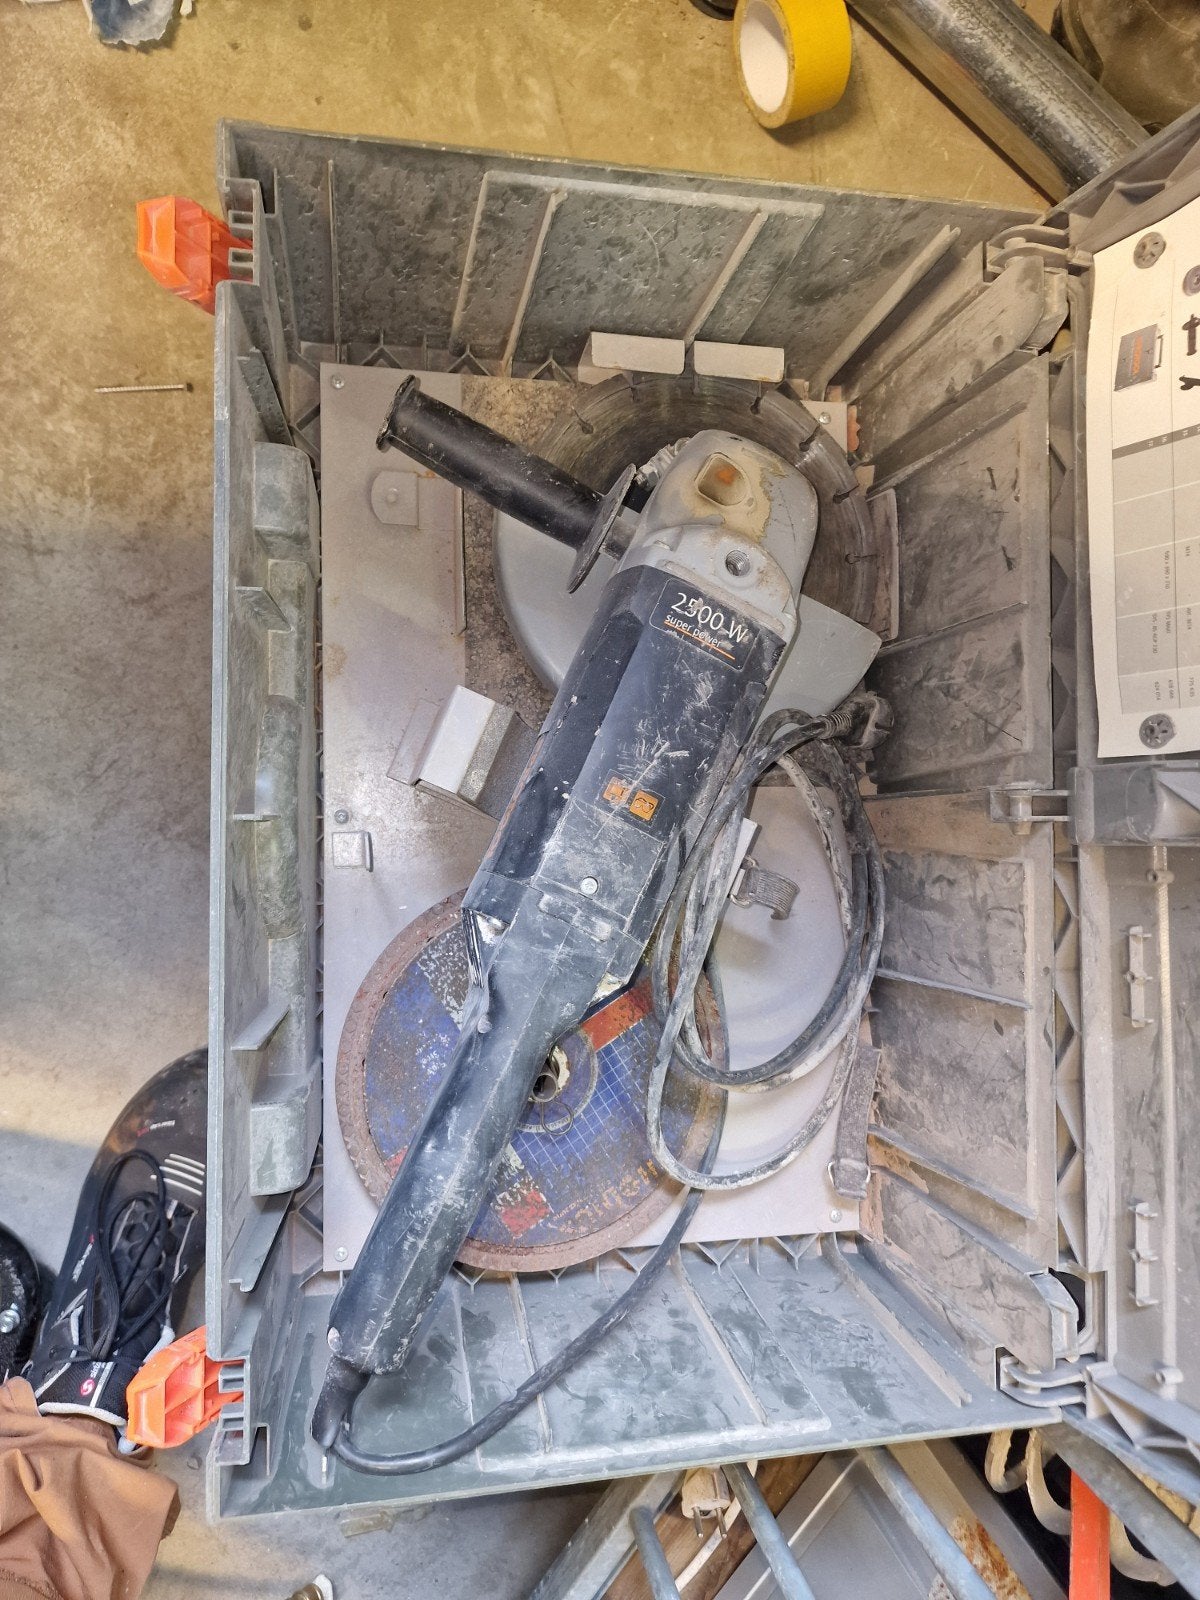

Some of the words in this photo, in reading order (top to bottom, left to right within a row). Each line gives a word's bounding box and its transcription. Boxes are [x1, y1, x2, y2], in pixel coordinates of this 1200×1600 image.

[666, 614, 694, 632] super
[692, 628, 722, 648] power
[671, 592, 725, 630] 2500
[728, 620, 749, 643] W
